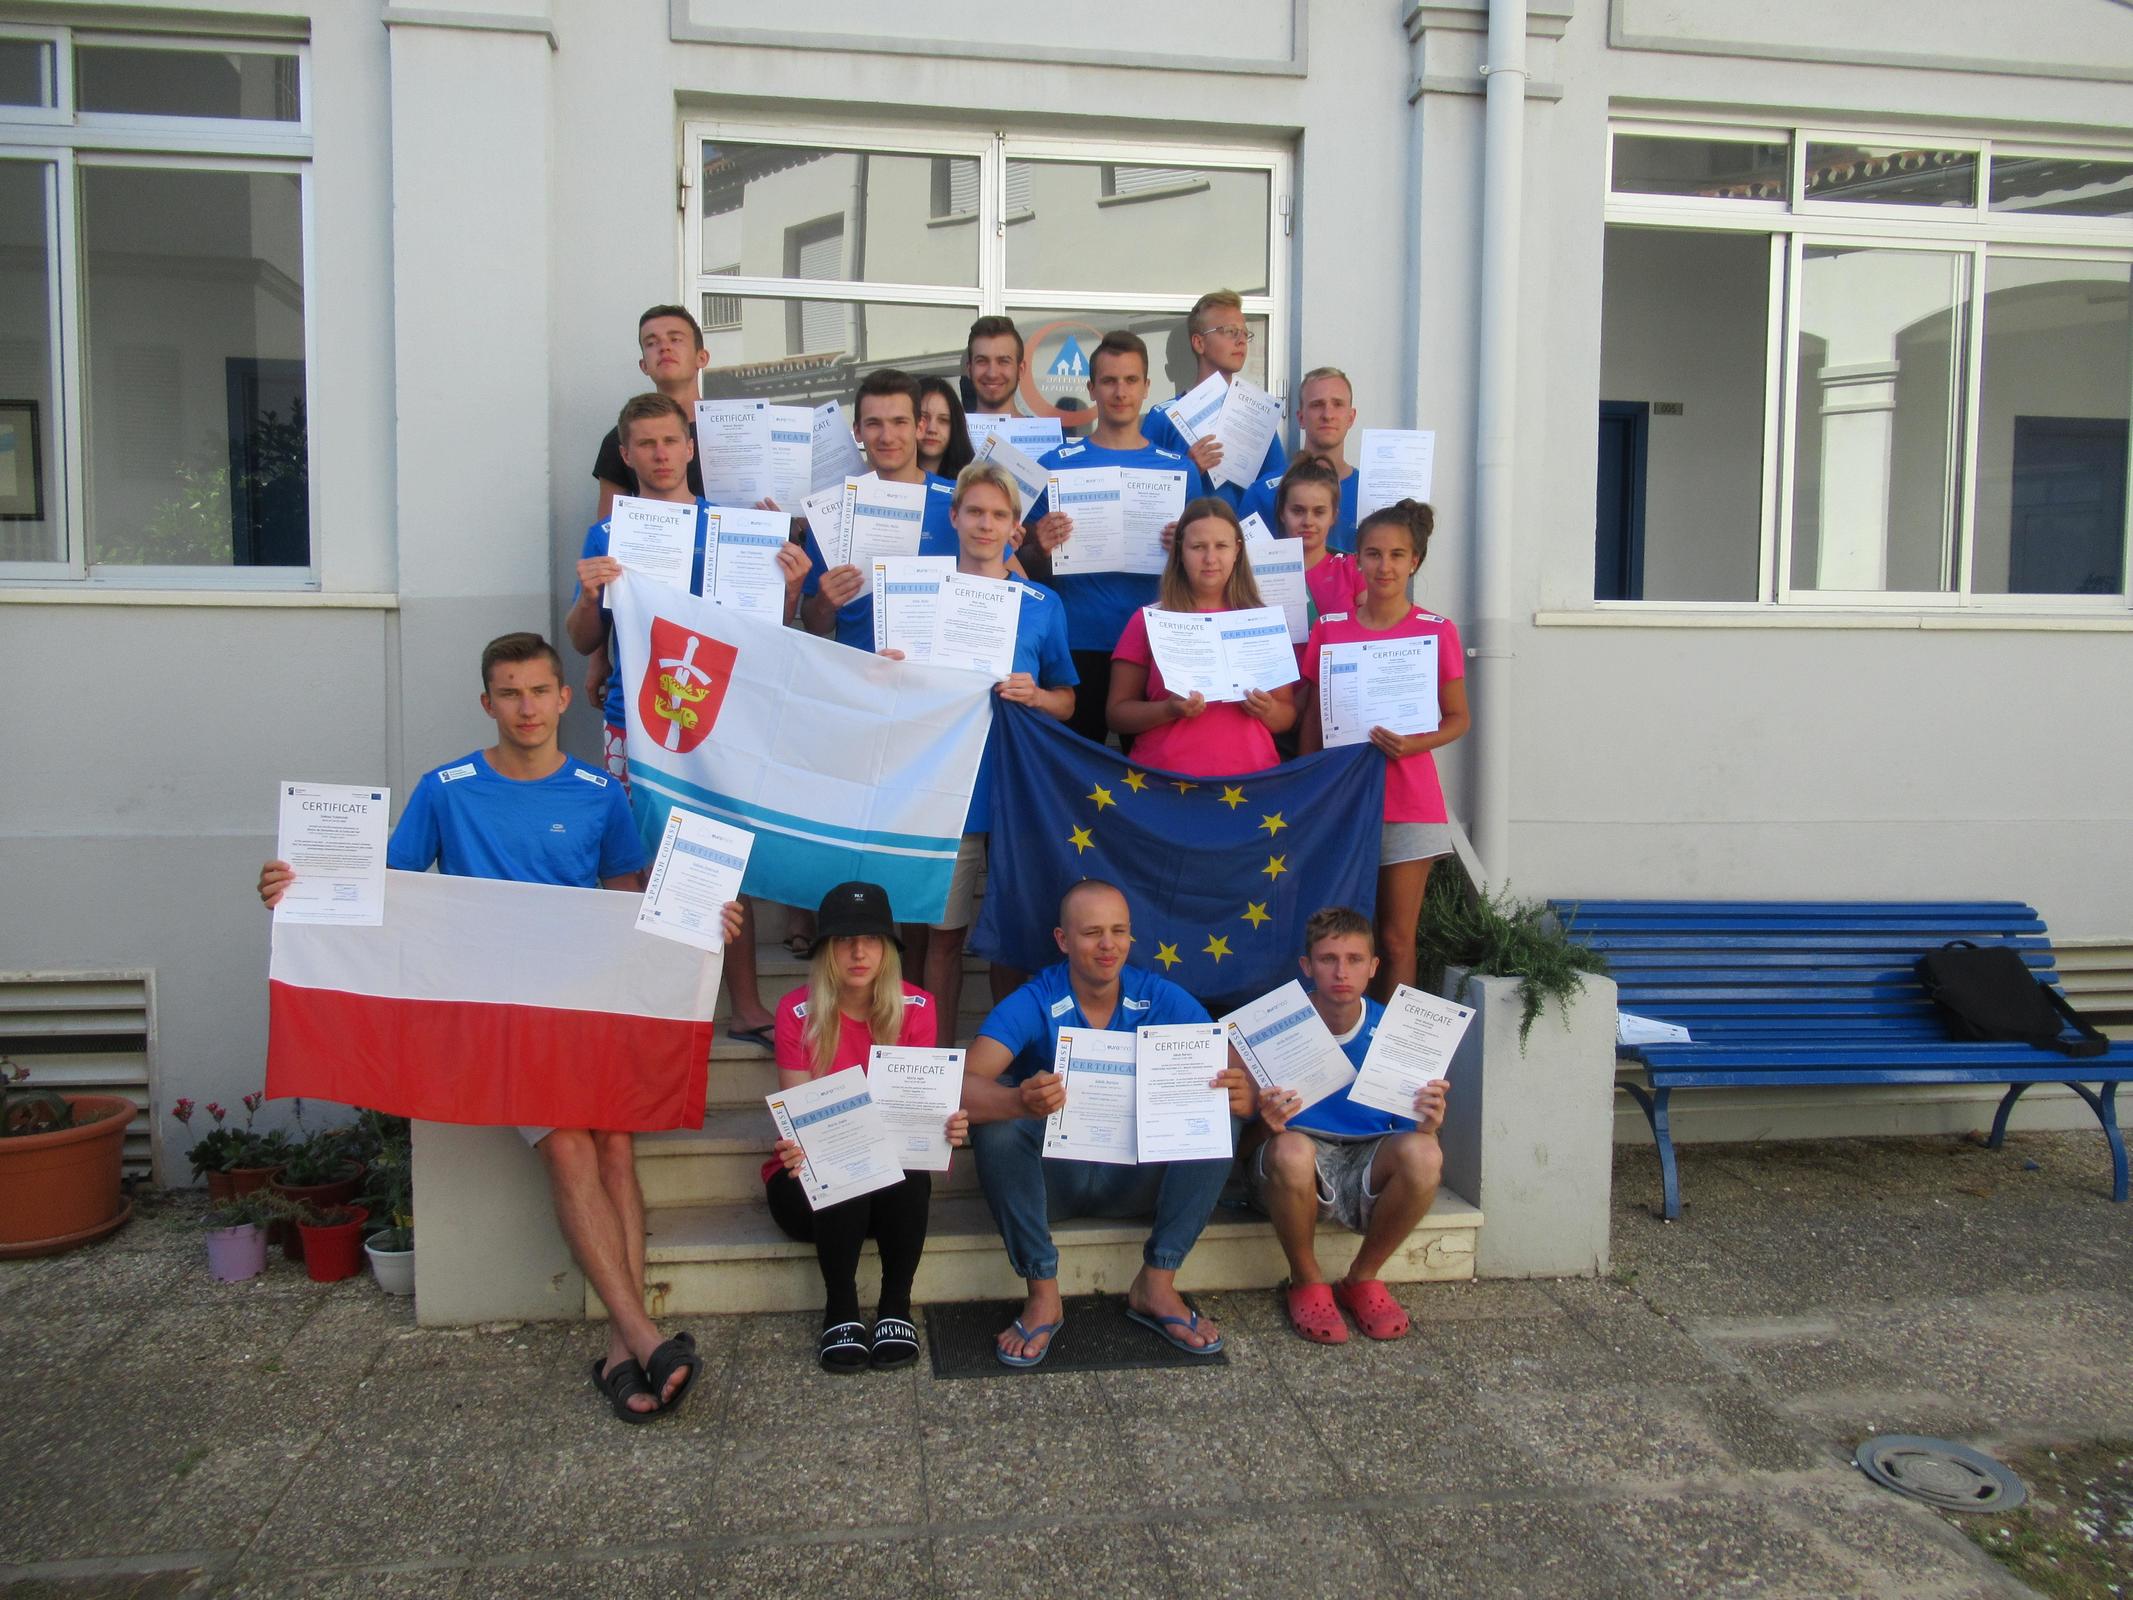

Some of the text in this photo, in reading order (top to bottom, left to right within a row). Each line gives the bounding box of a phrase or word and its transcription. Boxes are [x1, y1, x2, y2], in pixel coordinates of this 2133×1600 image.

[1238, 393, 1271, 415] CERTIFICATE
[710, 413, 756, 423] CERTIFICATE
[772, 432, 811, 441] IFICATE
[1127, 481, 1172, 492] CERTIFICATE
[1061, 491, 1120, 503] CERTIFICATE
[628, 512, 680, 525] CERTIFICATE
[857, 504, 921, 520] CERTIFICATE
[721, 534, 780, 545] CERTIFICAT
[706, 521, 718, 593] SPANISH COURSE
[1255, 564, 1302, 573] RTIFICATE
[888, 584, 939, 593] CERTIFICA
[955, 588, 1005, 603] CERTIFICATE
[1159, 621, 1205, 631] CERTIFICATE
[1372, 649, 1422, 660] CERTIFICATE
[302, 801, 368, 814] CERTIFICATE
[648, 822, 677, 900] SPANISH COURSE
[677, 841, 744, 870] CERTIFICATE
[1404, 1003, 1454, 1026] CERTIFICATE
[1249, 1007, 1314, 1045] CERTIFICATE
[1154, 1040, 1211, 1052] CERTIFICATE
[1229, 1031, 1271, 1088] ANISH COURSE
[887, 1063, 945, 1075] CERTIFICATE
[1072, 1060, 1134, 1073] CERTIFICA
[795, 1094, 872, 1127] CERTIFICATE
[776, 1109, 793, 1137] OURSE
